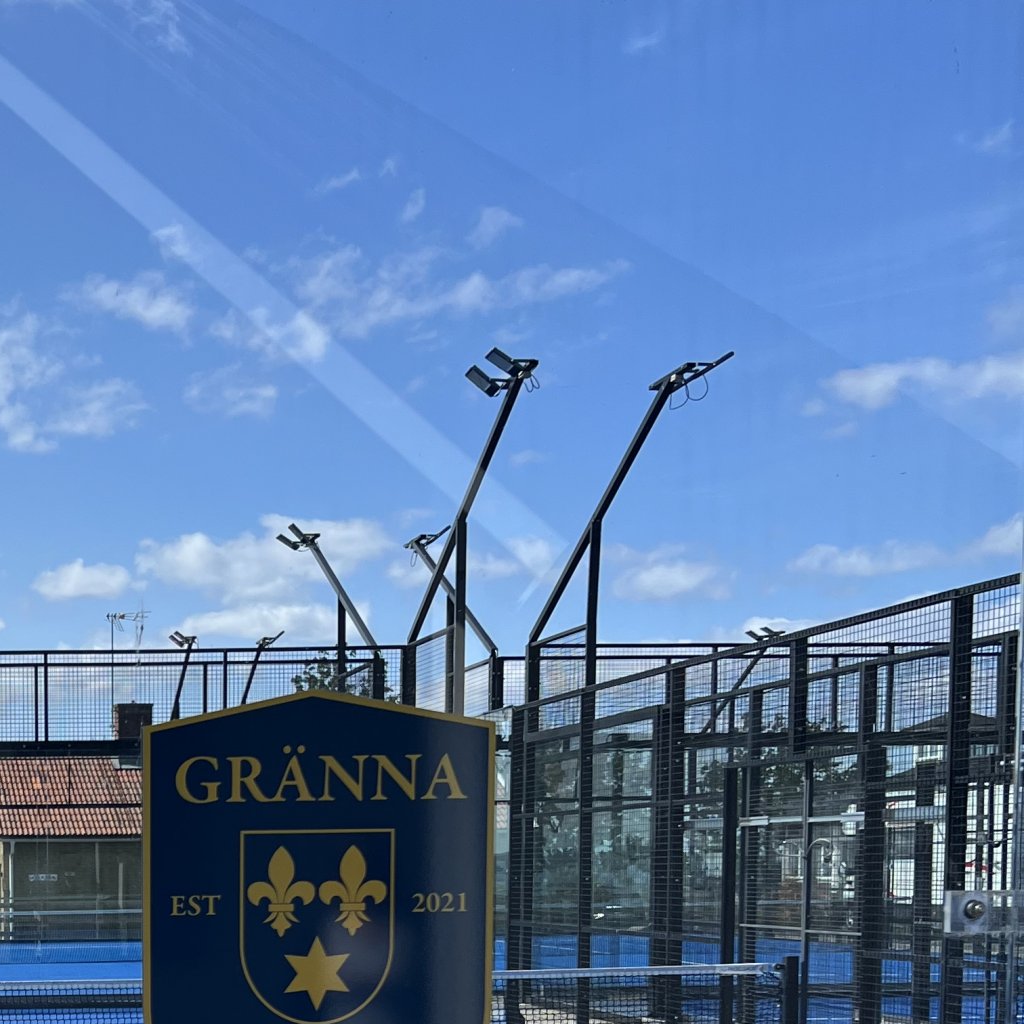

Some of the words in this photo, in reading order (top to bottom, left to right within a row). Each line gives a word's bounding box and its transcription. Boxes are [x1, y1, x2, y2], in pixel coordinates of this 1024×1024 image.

[175, 745, 468, 804] GRÄNNA
[170, 894, 221, 917] EST
[411, 892, 468, 913] 2021
